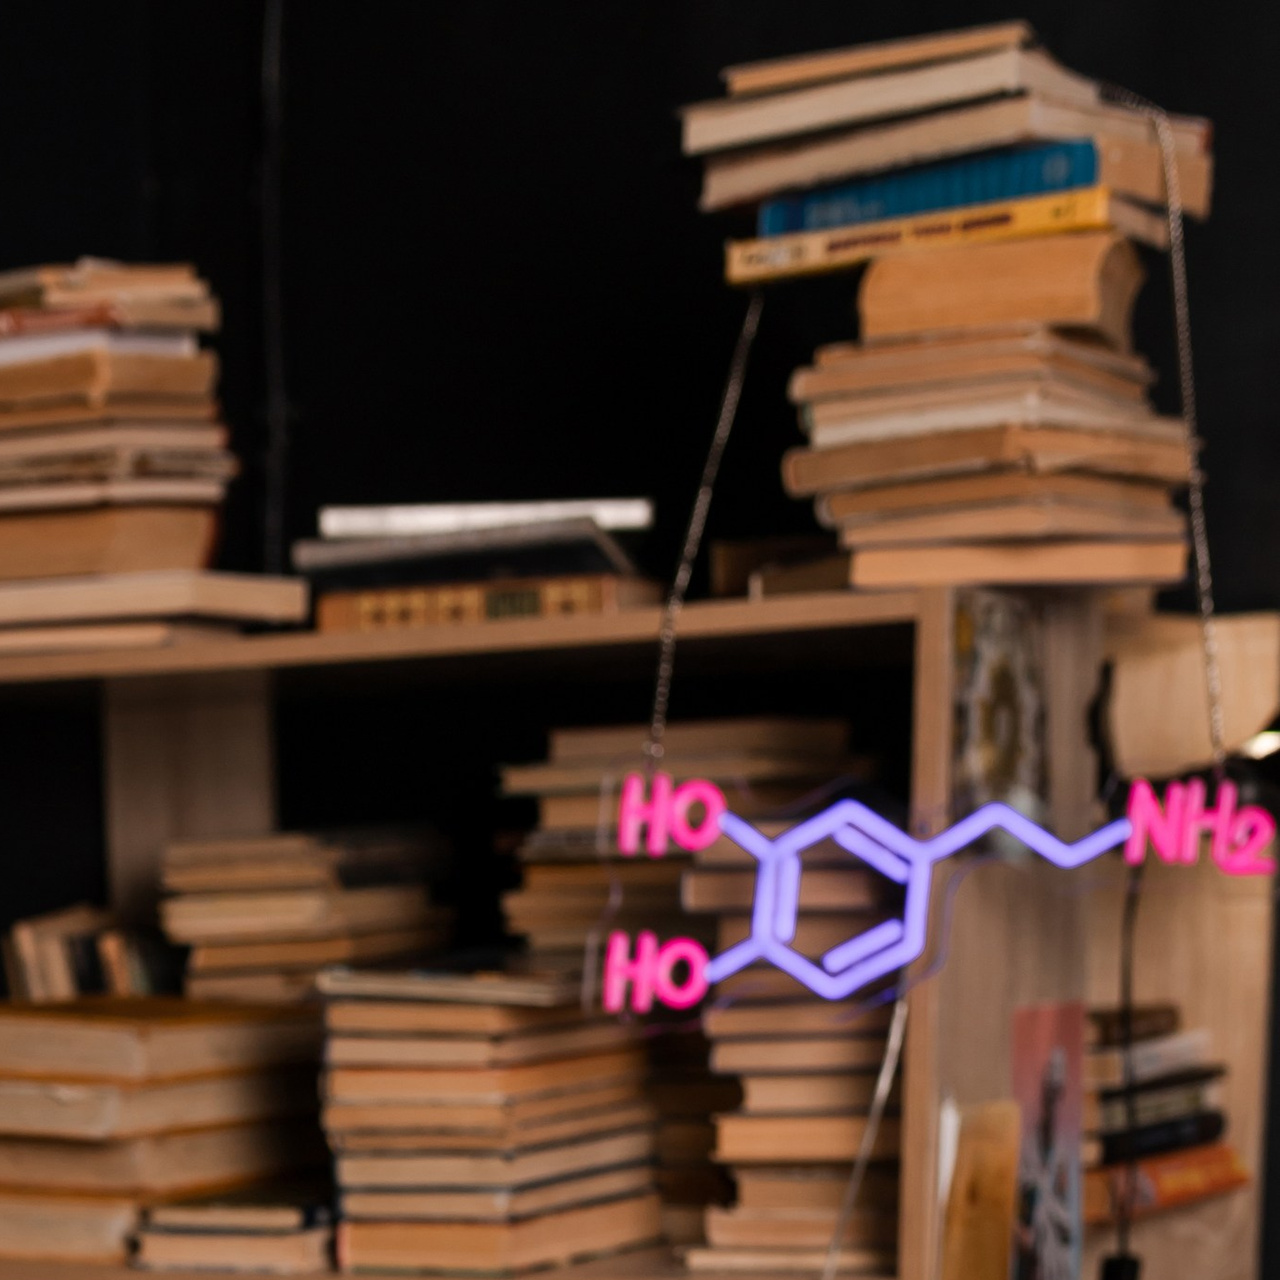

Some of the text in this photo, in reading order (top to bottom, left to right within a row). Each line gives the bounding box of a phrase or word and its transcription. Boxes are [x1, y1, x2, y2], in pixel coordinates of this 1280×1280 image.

[618, 771, 726, 857] HO
[1125, 777, 1279, 876] NH2
[604, 930, 711, 1013] HO
